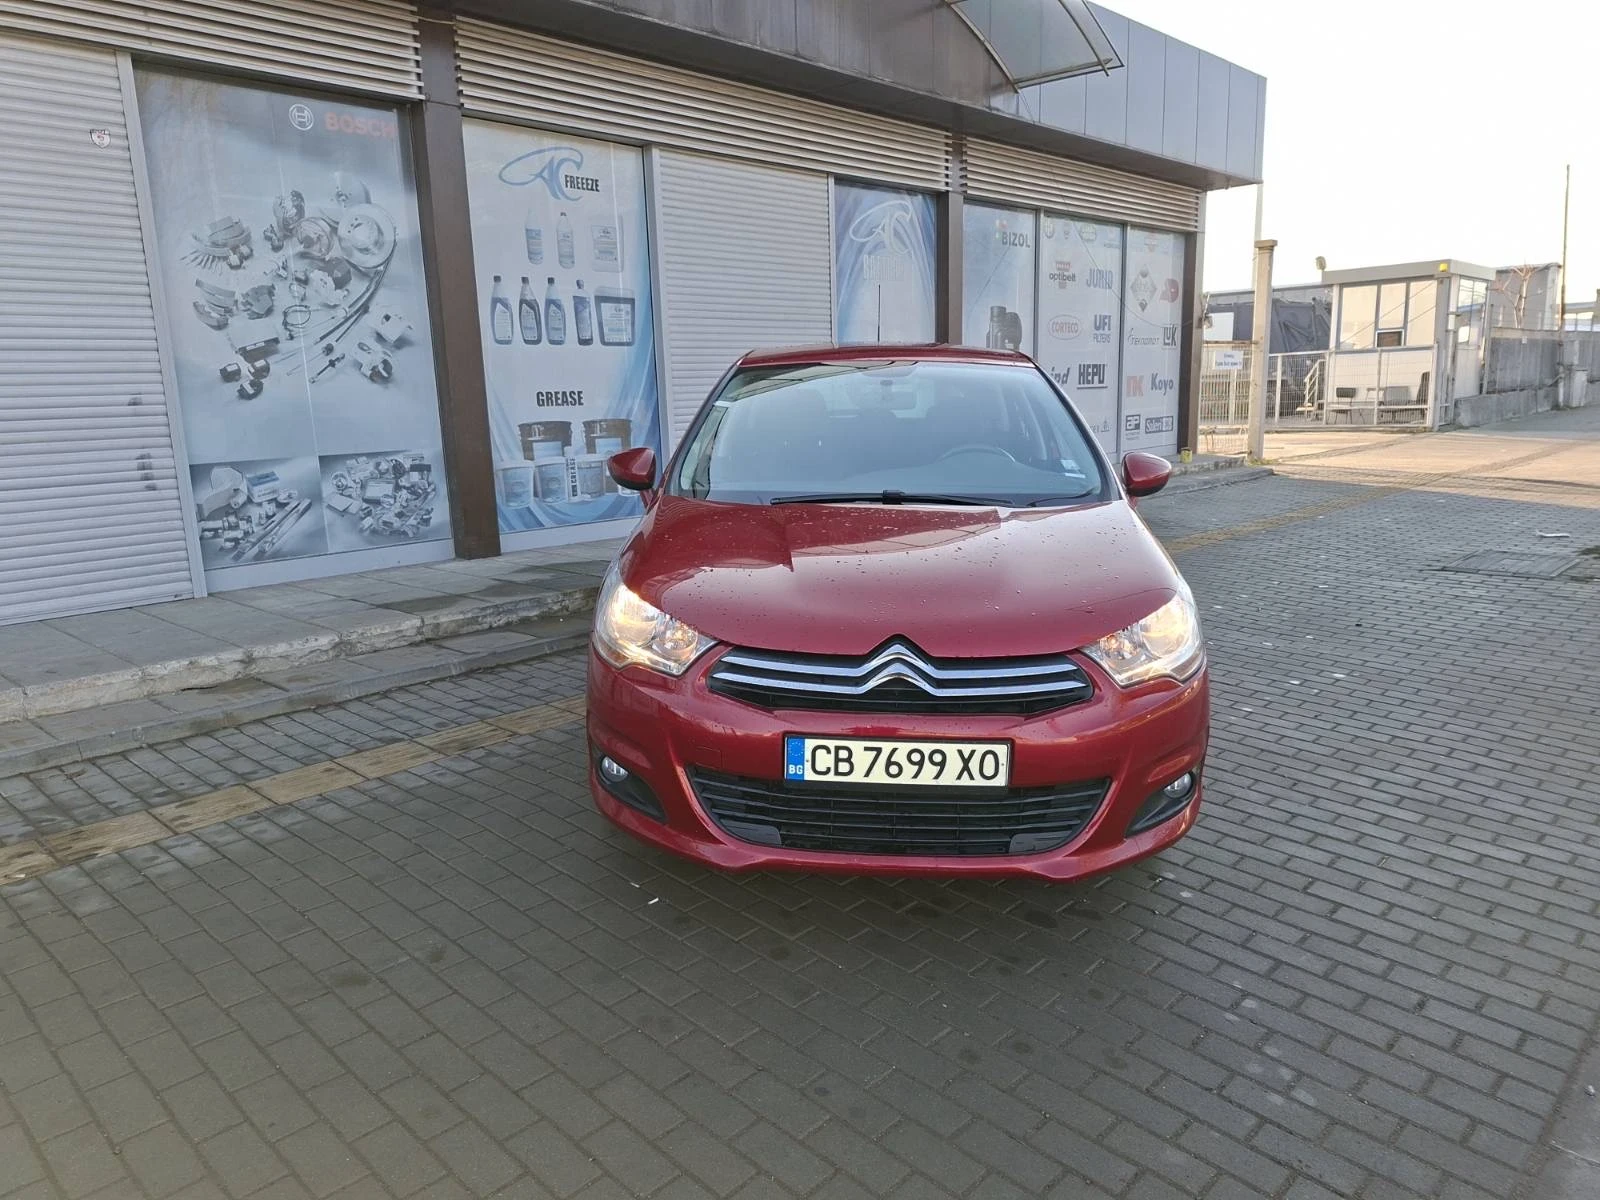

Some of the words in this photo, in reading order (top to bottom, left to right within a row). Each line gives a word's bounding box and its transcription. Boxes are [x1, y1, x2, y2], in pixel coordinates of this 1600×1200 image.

[325, 112, 396, 138] BOSCH
[1001, 231, 1031, 248] BIZOL
[1049, 272, 1076, 282] optibelt
[1051, 321, 1079, 334] CORTECO
[1094, 314, 1111, 331] UFI
[1078, 364, 1105, 385] HEPU
[1150, 373, 1174, 396] Koyo
[536, 391, 584, 407] GREASE
[788, 766, 803, 774] BG
[810, 744, 854, 777] CB
[863, 746, 947, 780] 7699
